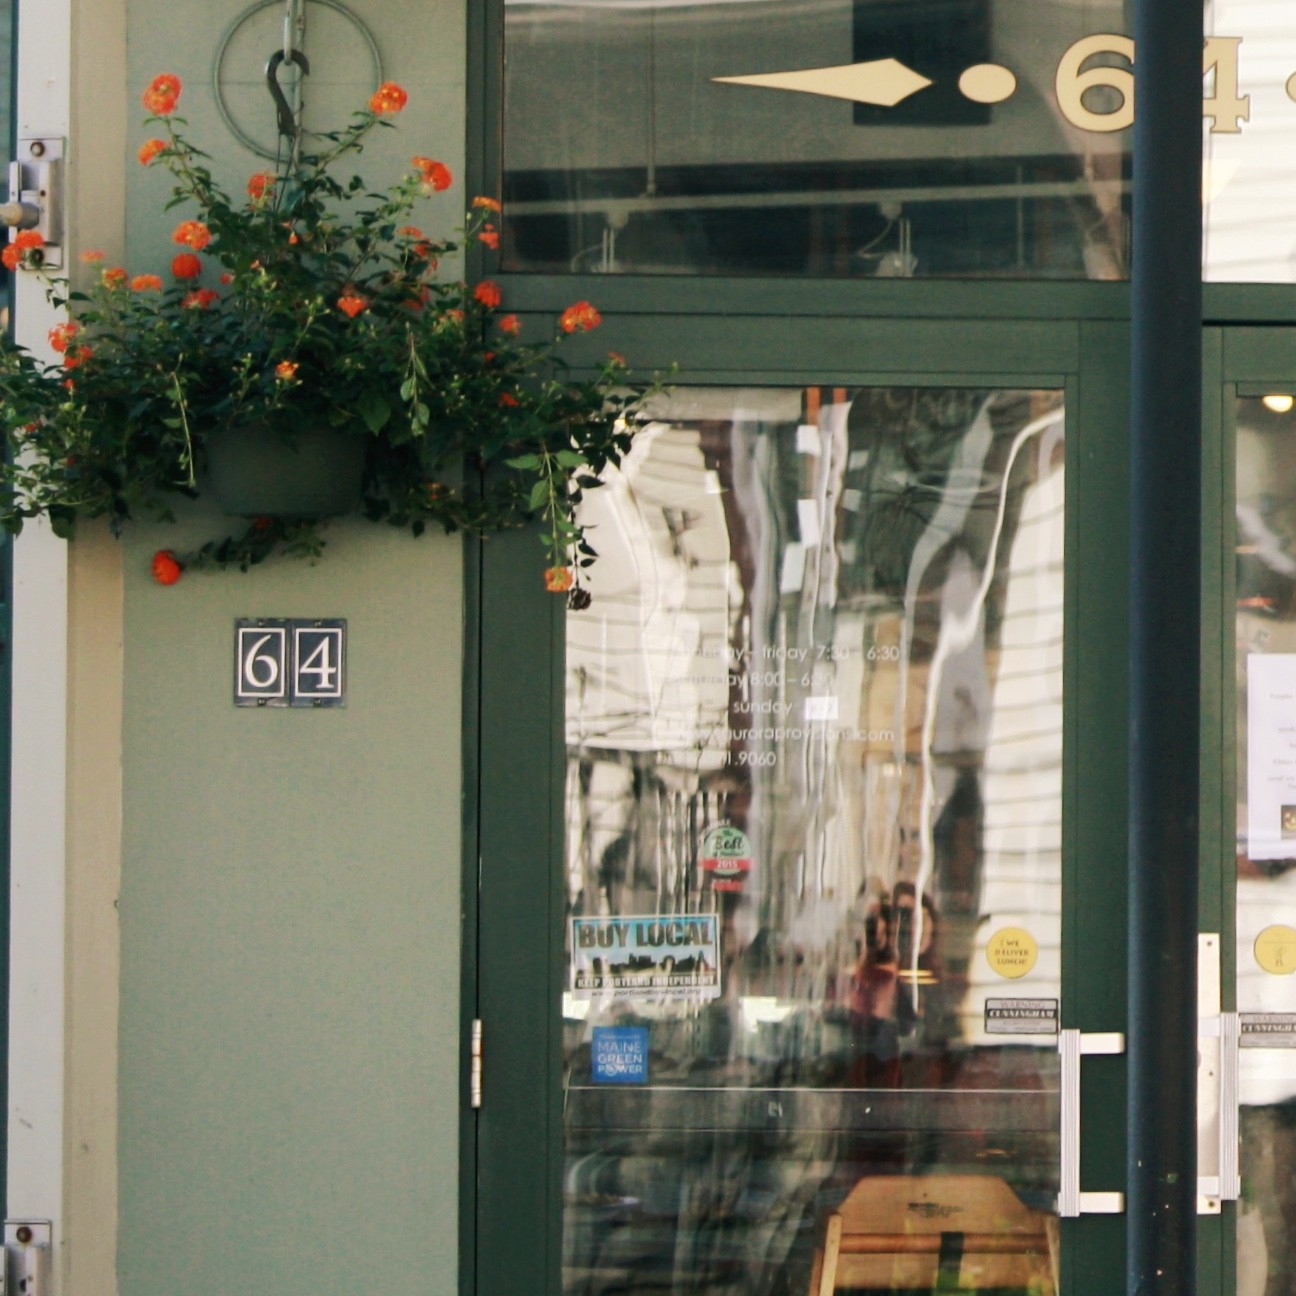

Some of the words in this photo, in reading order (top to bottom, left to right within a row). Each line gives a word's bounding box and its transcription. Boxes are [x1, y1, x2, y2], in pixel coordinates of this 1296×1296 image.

[244, 633, 337, 689] 64
[867, 645, 900, 662] 6:30
[732, 698, 794, 717] sunday
[578, 921, 631, 948] BUY
[635, 920, 713, 947] LOCAL
[597, 1040, 642, 1054] MAINE
[597, 1053, 643, 1064] GREEN
